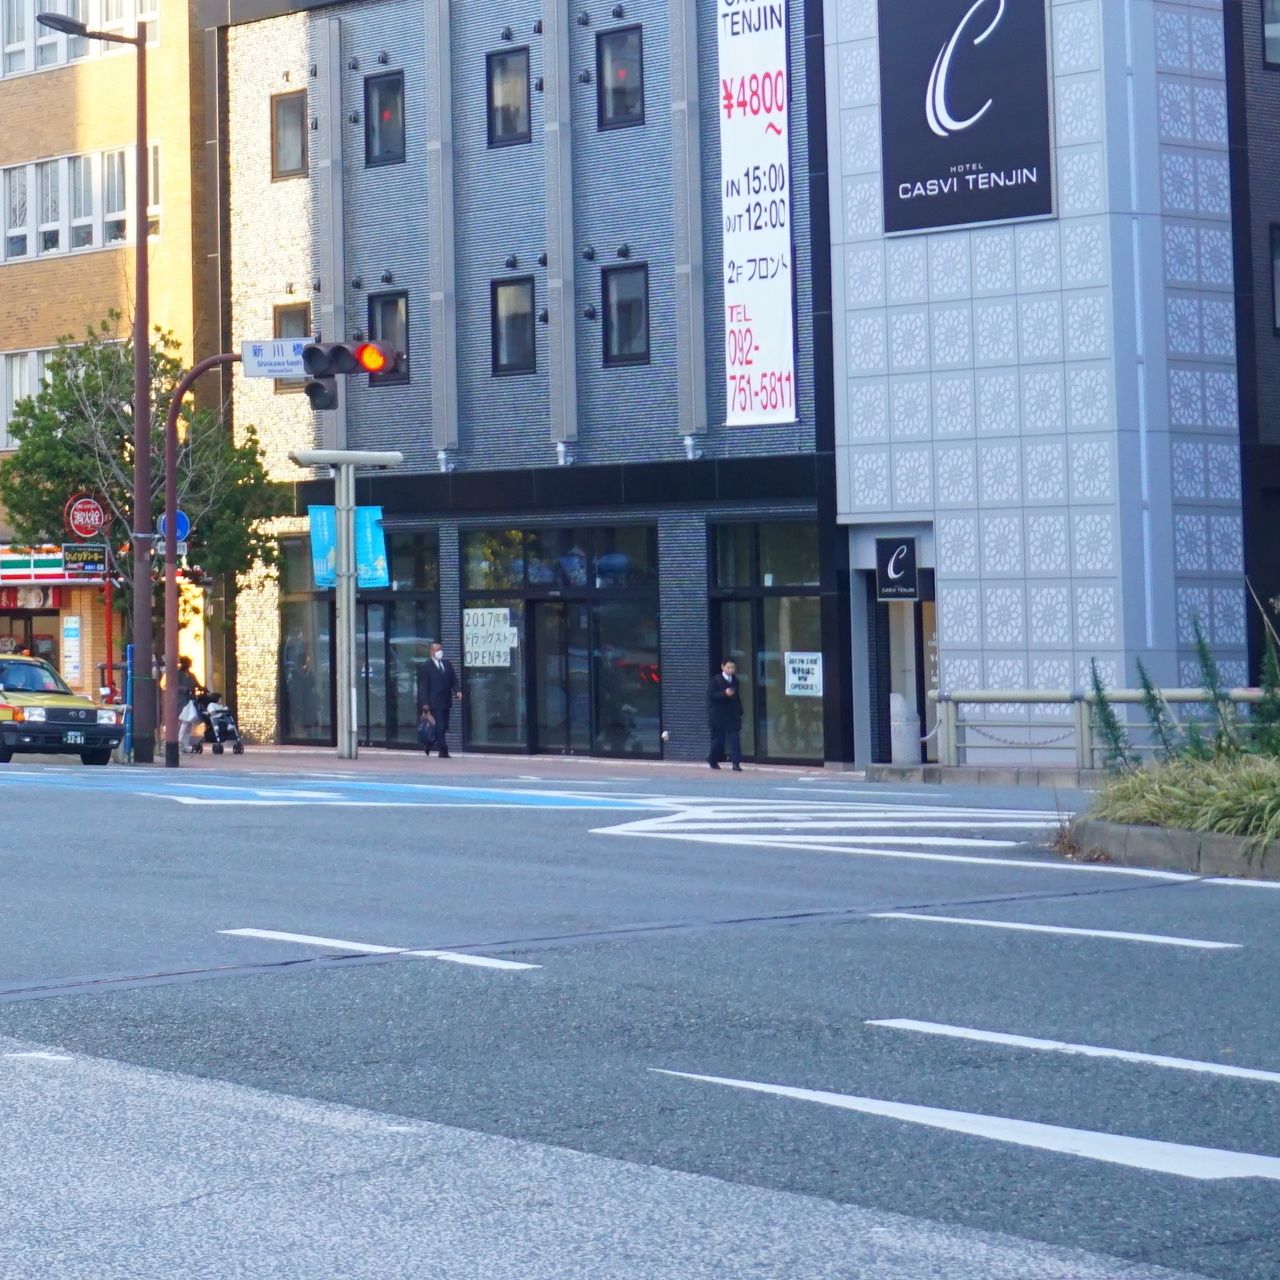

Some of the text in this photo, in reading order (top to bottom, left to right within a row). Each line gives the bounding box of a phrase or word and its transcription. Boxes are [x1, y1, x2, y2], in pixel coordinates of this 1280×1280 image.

[722, 4, 783, 38] TENJIN
[726, 162, 785, 198] IN 15:00
[898, 167, 1038, 199] CASVI TENJIN
[949, 162, 984, 174] HOTEL
[745, 198, 786, 232] 12:00
[727, 252, 788, 284] 2F フロント
[728, 303, 752, 323] TEL
[729, 370, 792, 413] 751-5811
